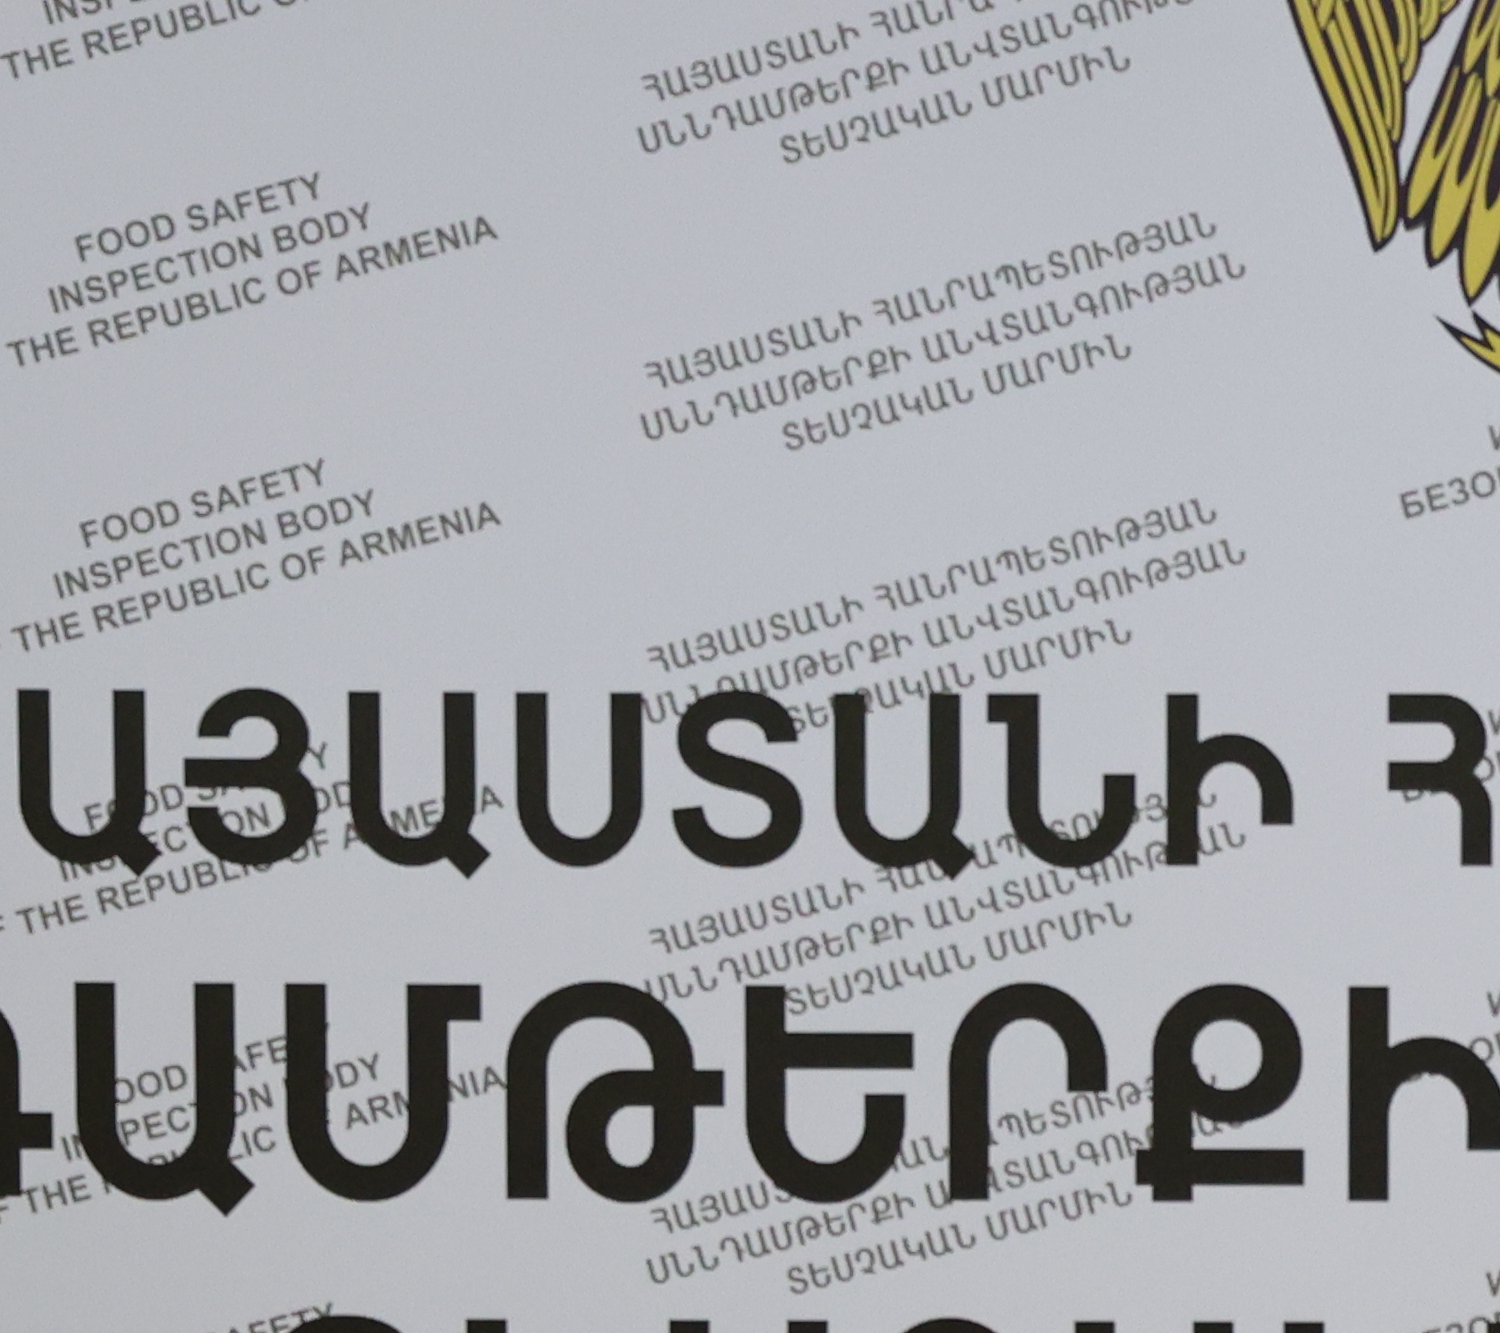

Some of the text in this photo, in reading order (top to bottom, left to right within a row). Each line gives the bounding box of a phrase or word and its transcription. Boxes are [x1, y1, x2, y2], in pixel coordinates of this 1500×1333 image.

[48, 202, 369, 313] INSPECTION BODY
[75, 172, 319, 262] FOOD SAFETY
[6, 327, 79, 367] THE
[87, 277, 266, 347] REPUBLIC
[276, 260, 321, 295] OF
[336, 216, 498, 282] ARMENIA
[53, 489, 373, 599] INSPECTION BODY
[79, 458, 324, 548] FOOD SAFETY
[11, 611, 84, 652] THE
[92, 563, 270, 632] REPUBLIC
[280, 546, 324, 581] OF
[340, 502, 501, 567] ARMENIA
